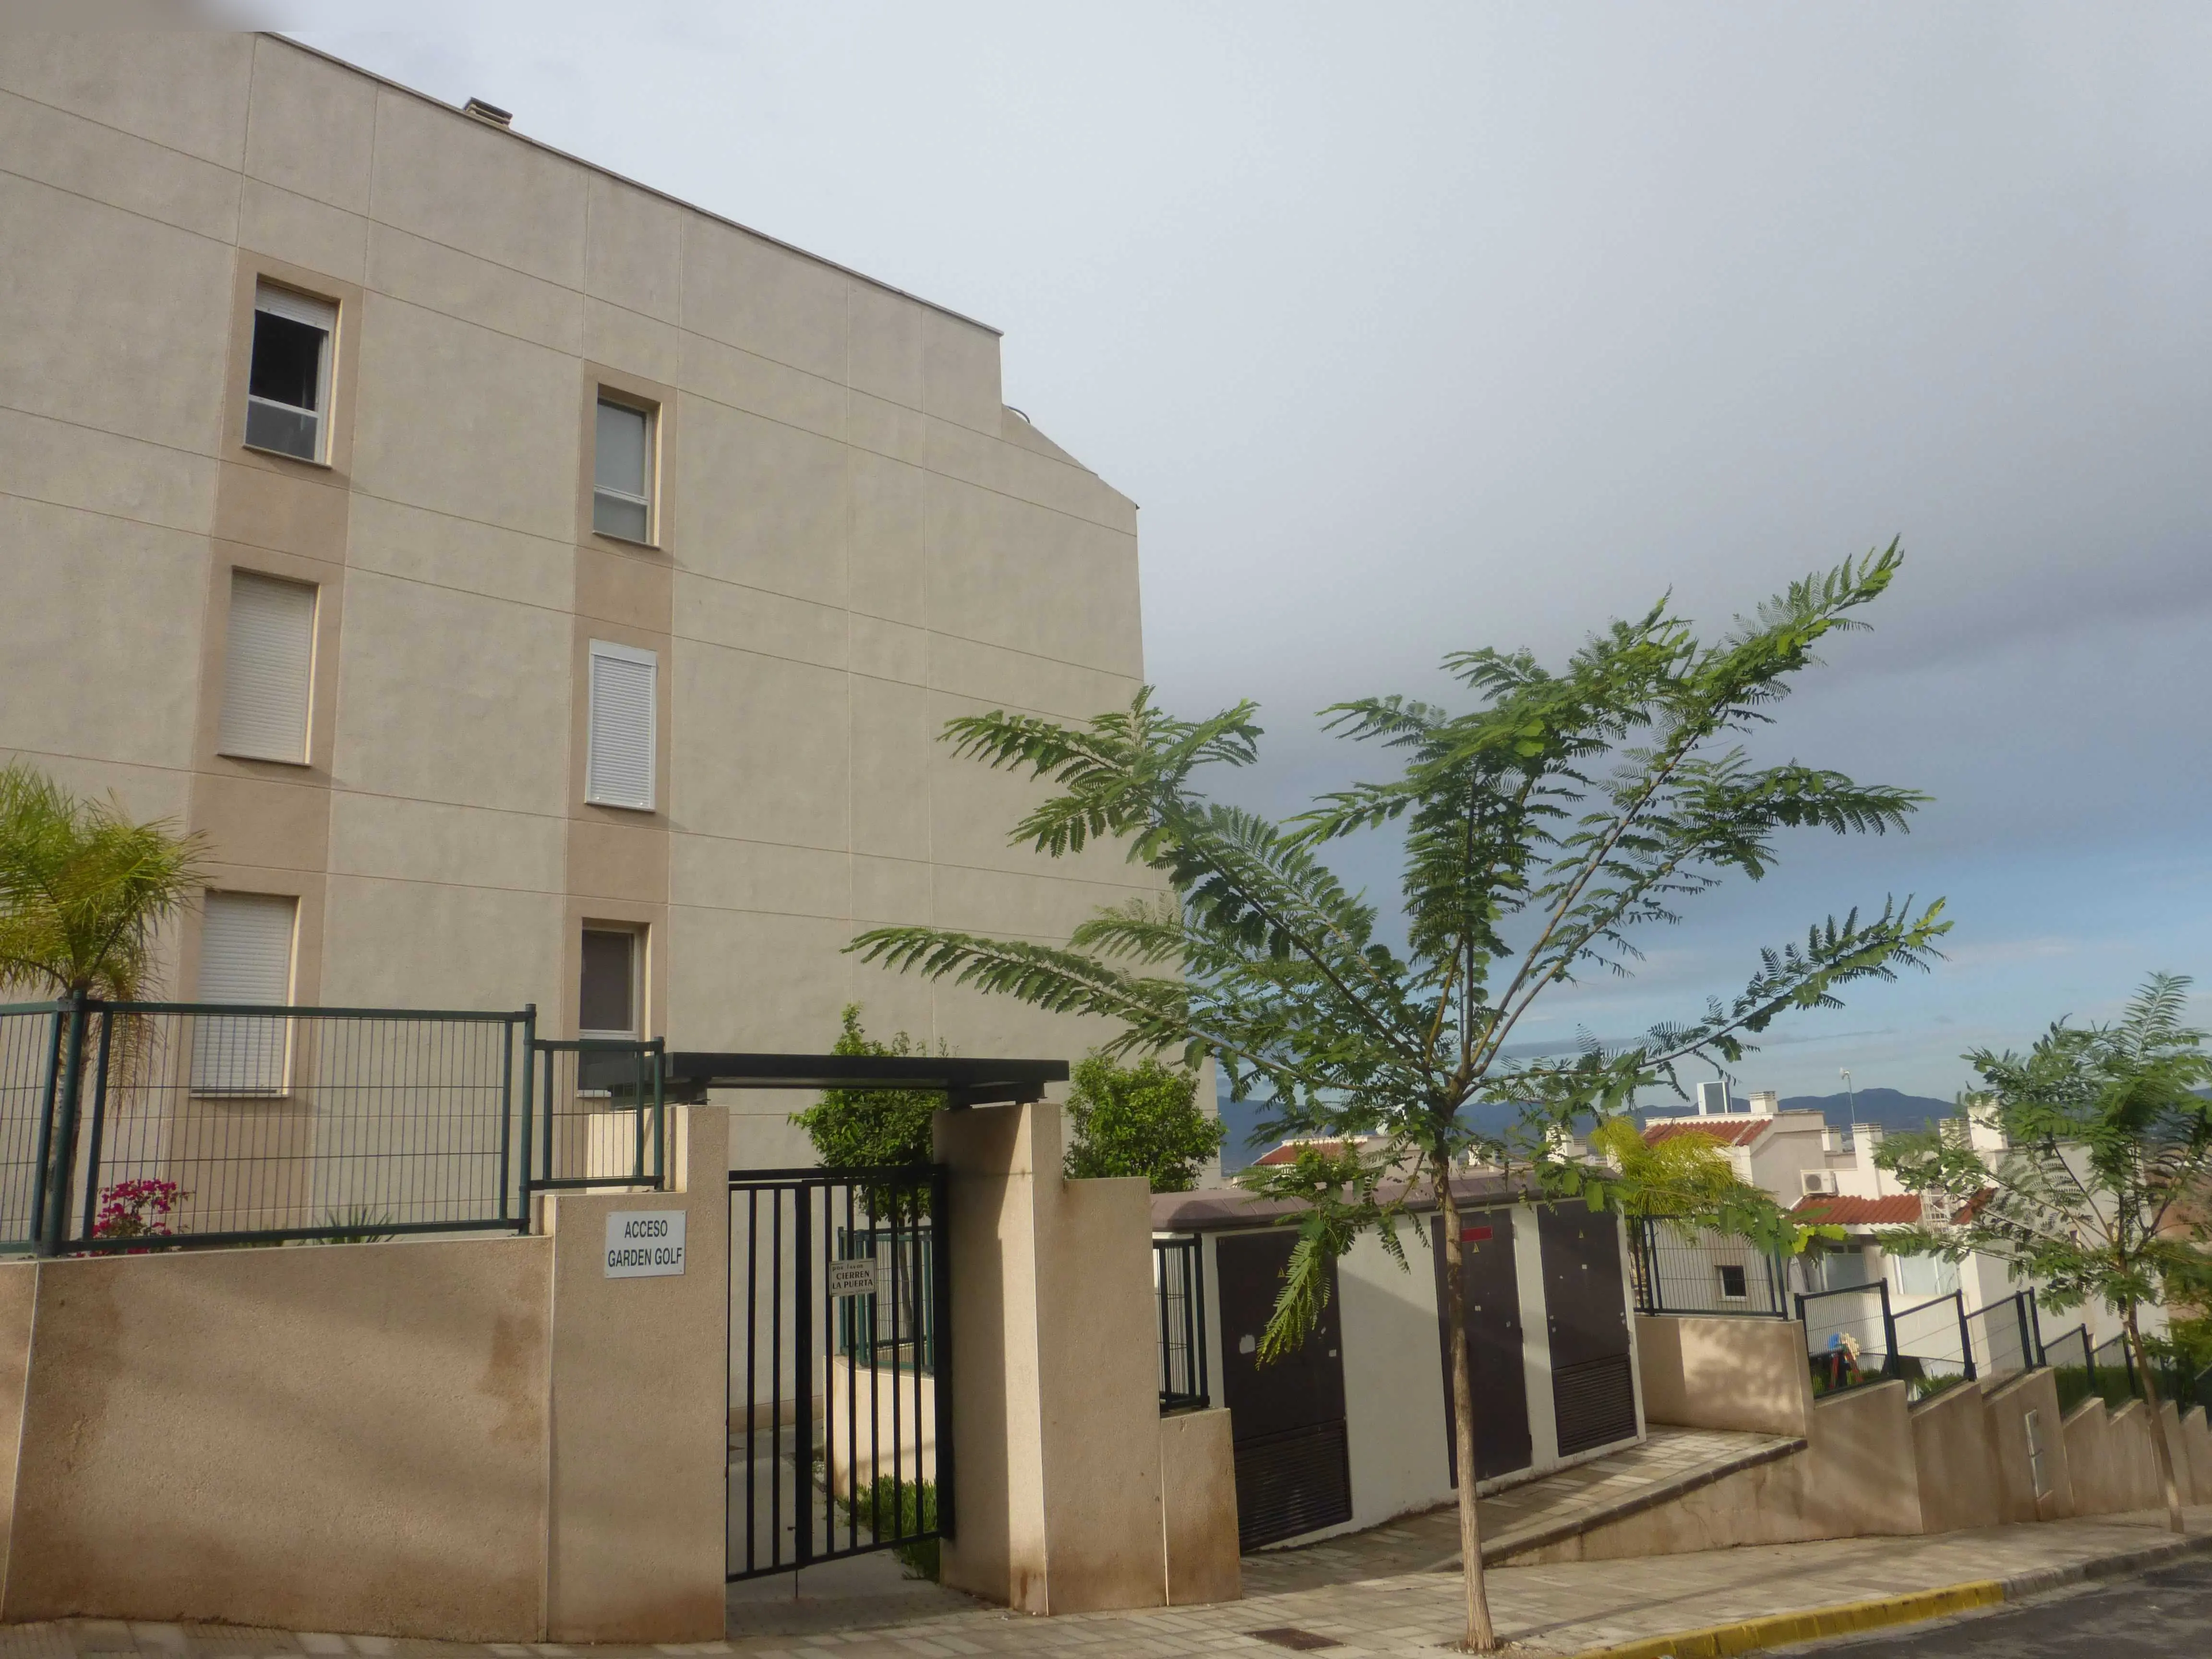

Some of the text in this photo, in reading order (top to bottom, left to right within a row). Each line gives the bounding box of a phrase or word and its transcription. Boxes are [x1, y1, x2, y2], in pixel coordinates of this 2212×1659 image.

[625, 1220, 668, 1238] ACCESO
[608, 1247, 682, 1267] GARDEN GOLF
[836, 1270, 870, 1280] CIERREN
[844, 1278, 873, 1288] PUERTA
